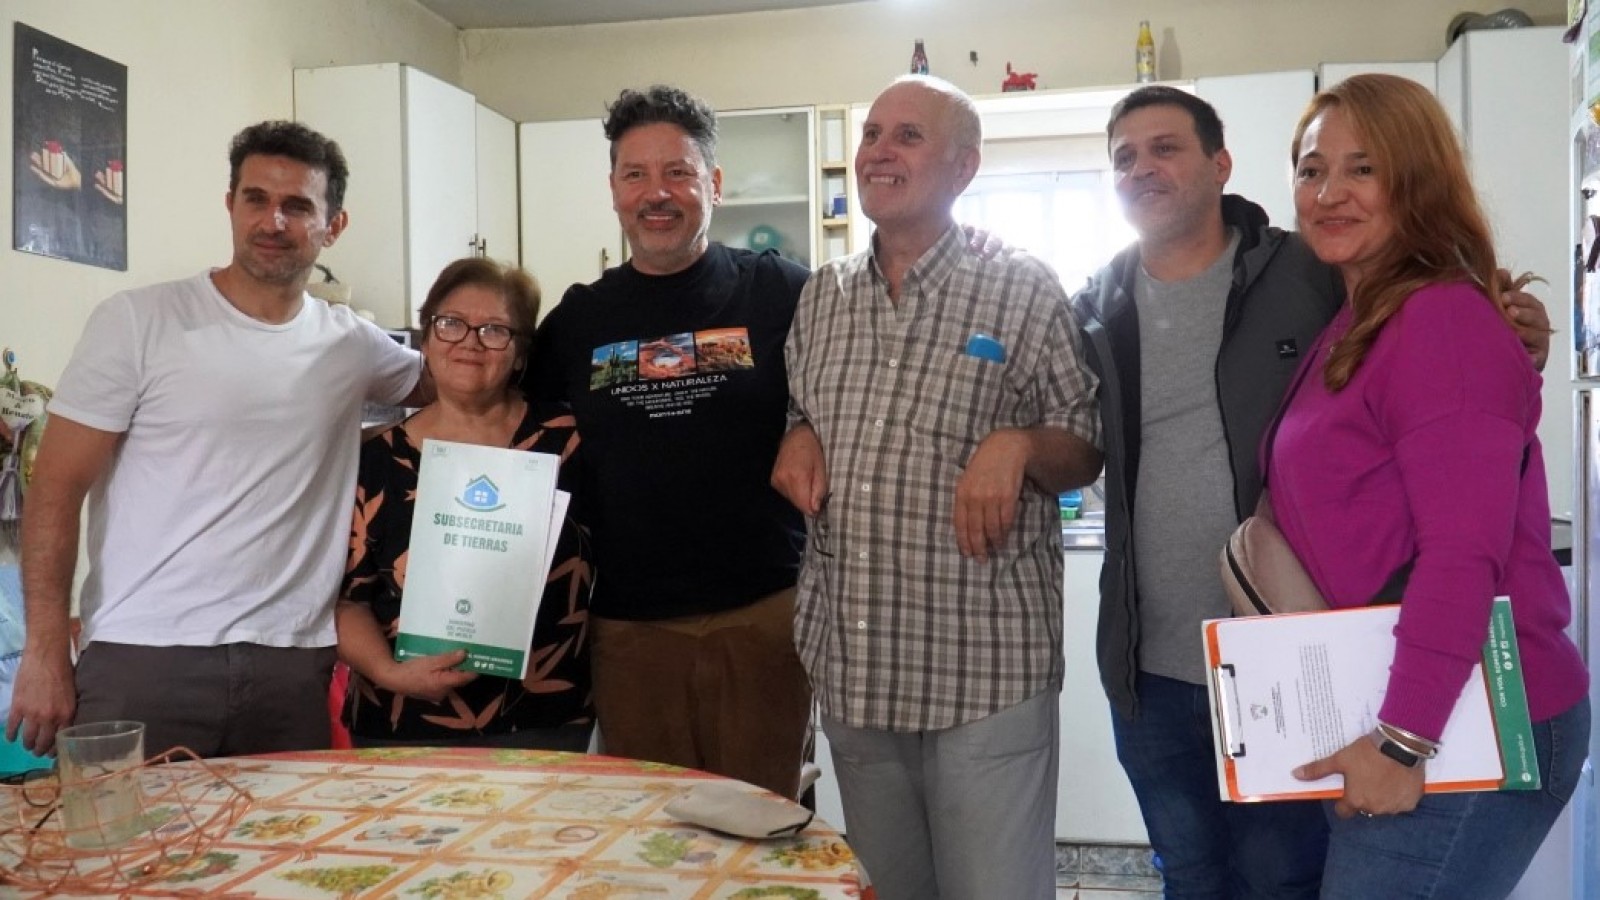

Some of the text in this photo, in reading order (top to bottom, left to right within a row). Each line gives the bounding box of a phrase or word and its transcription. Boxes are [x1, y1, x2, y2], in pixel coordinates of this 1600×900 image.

[611, 384, 648, 395] UNIDOS
[651, 382, 659, 390] X
[661, 374, 727, 389] NATURALEZA
[433, 513, 523, 535] SUBSECRETARIA
[443, 532, 508, 553] DE TIERRAS
